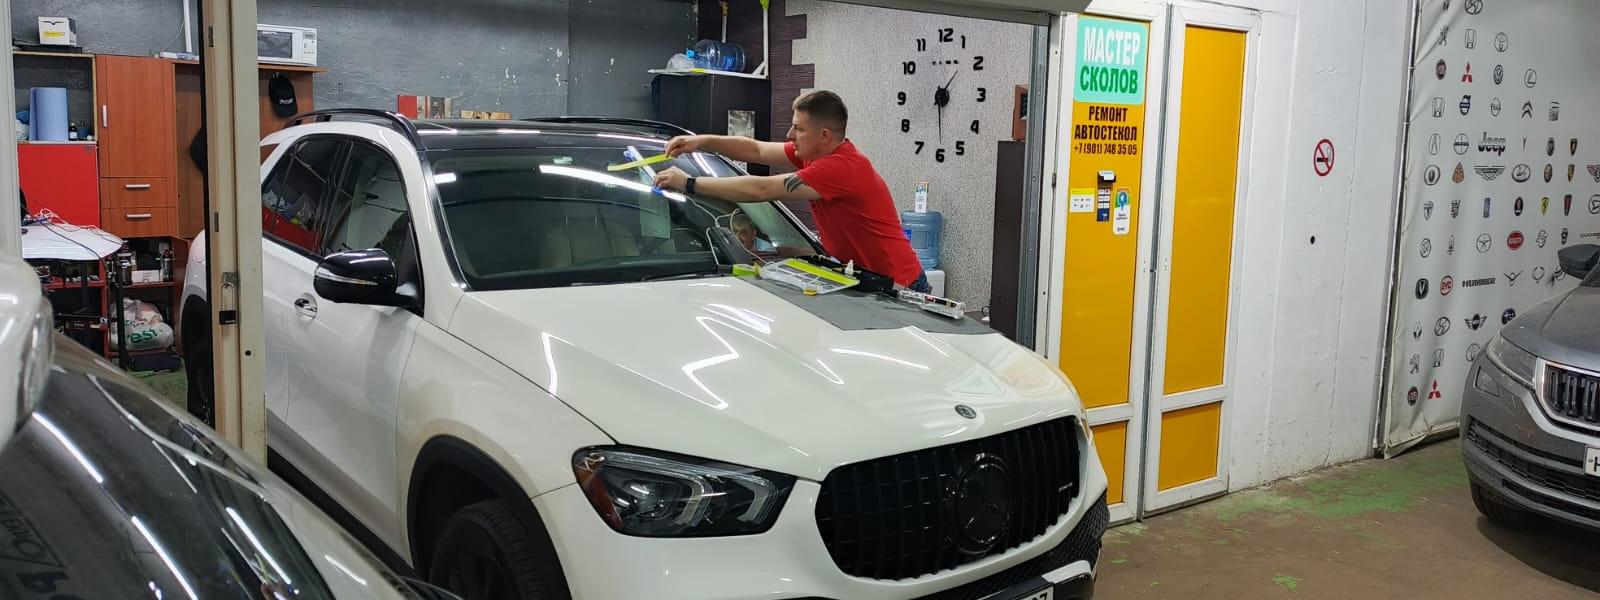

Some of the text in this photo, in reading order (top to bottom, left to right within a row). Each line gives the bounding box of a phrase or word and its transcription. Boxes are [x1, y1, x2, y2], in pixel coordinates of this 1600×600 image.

[938, 28, 954, 43] 12
[961, 35, 966, 49] 1
[916, 38, 926, 52] 11
[1083, 26, 1140, 65] МАСТЕР
[902, 61, 916, 75] 10
[973, 56, 984, 71] 2
[1080, 65, 1138, 94] СКОЛОВ
[897, 91, 906, 105] 9
[976, 88, 986, 102] 3
[1088, 106, 1128, 122] РЕМОНТ
[901, 119, 910, 132] 8
[970, 120, 979, 134] 4
[1074, 124, 1137, 141] АВТОСТЕКОЛ
[914, 141, 924, 155] 7
[956, 141, 965, 156] 5
[1083, 143, 1102, 154] (901)
[1104, 143, 1116, 155] 748
[1117, 144, 1127, 155] 35
[1127, 144, 1137, 156] 05
[1478, 131, 1506, 156] Jeep
[935, 148, 945, 163] 6
[1462, 277, 1496, 288] HUMMER
